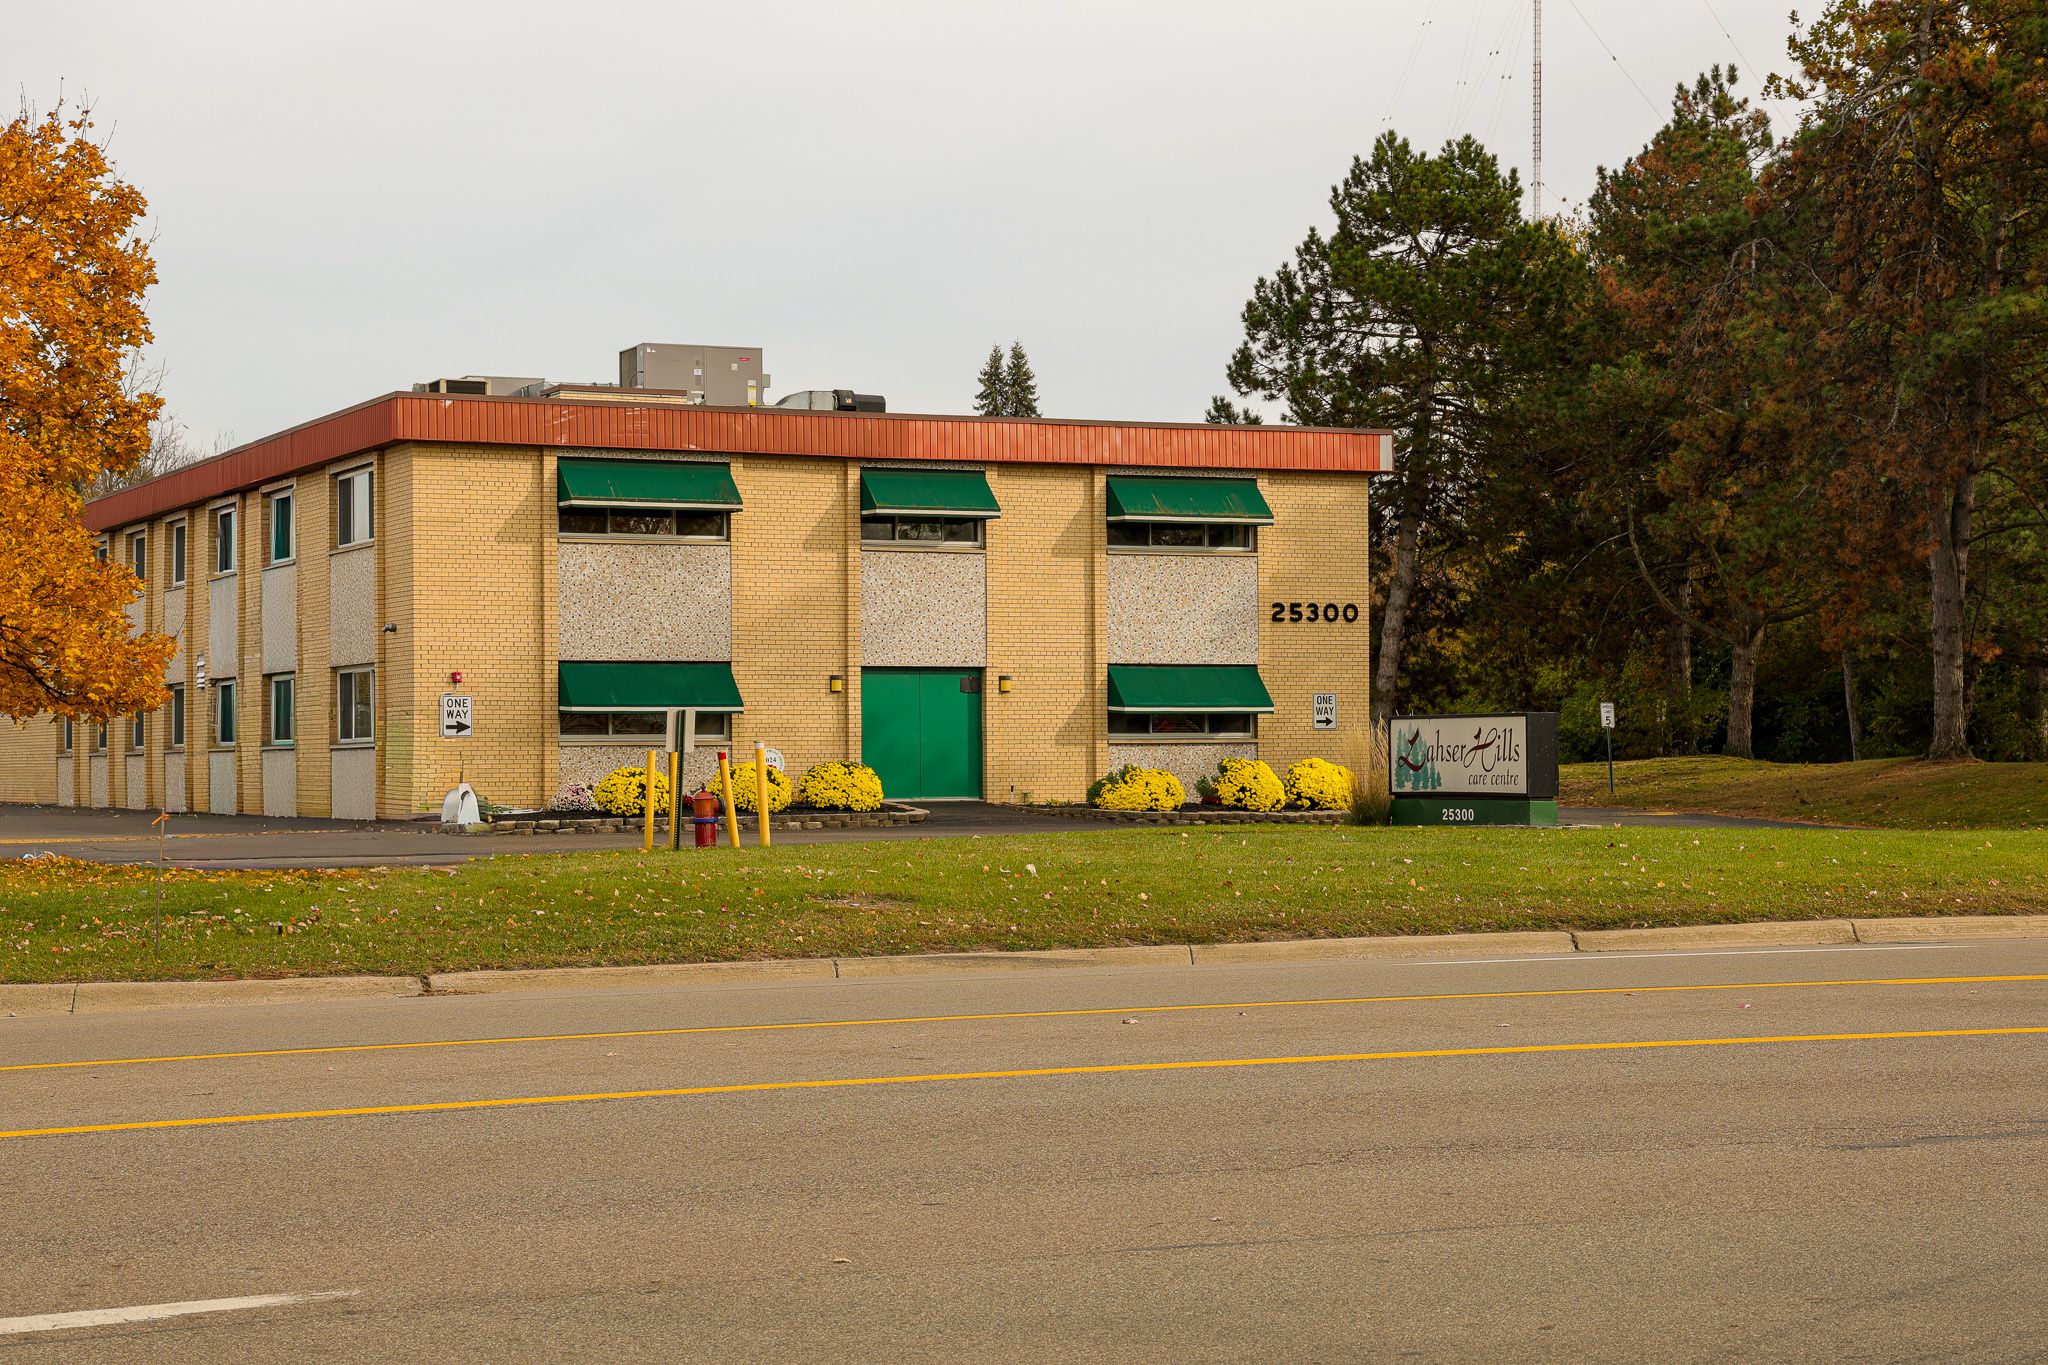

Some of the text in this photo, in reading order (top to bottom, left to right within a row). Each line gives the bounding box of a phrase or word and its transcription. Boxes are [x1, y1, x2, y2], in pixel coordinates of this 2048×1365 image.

[1272, 602, 1359, 622] 25300
[446, 698, 469, 708] ONE
[1316, 696, 1333, 705] ONE
[446, 709, 469, 719] WAY
[1315, 706, 1334, 715] WAY
[1605, 715, 1611, 725] 5
[1398, 726, 1520, 773] Lahser Hills
[1468, 769, 1520, 786] care centre
[1442, 808, 1475, 822] 25300
